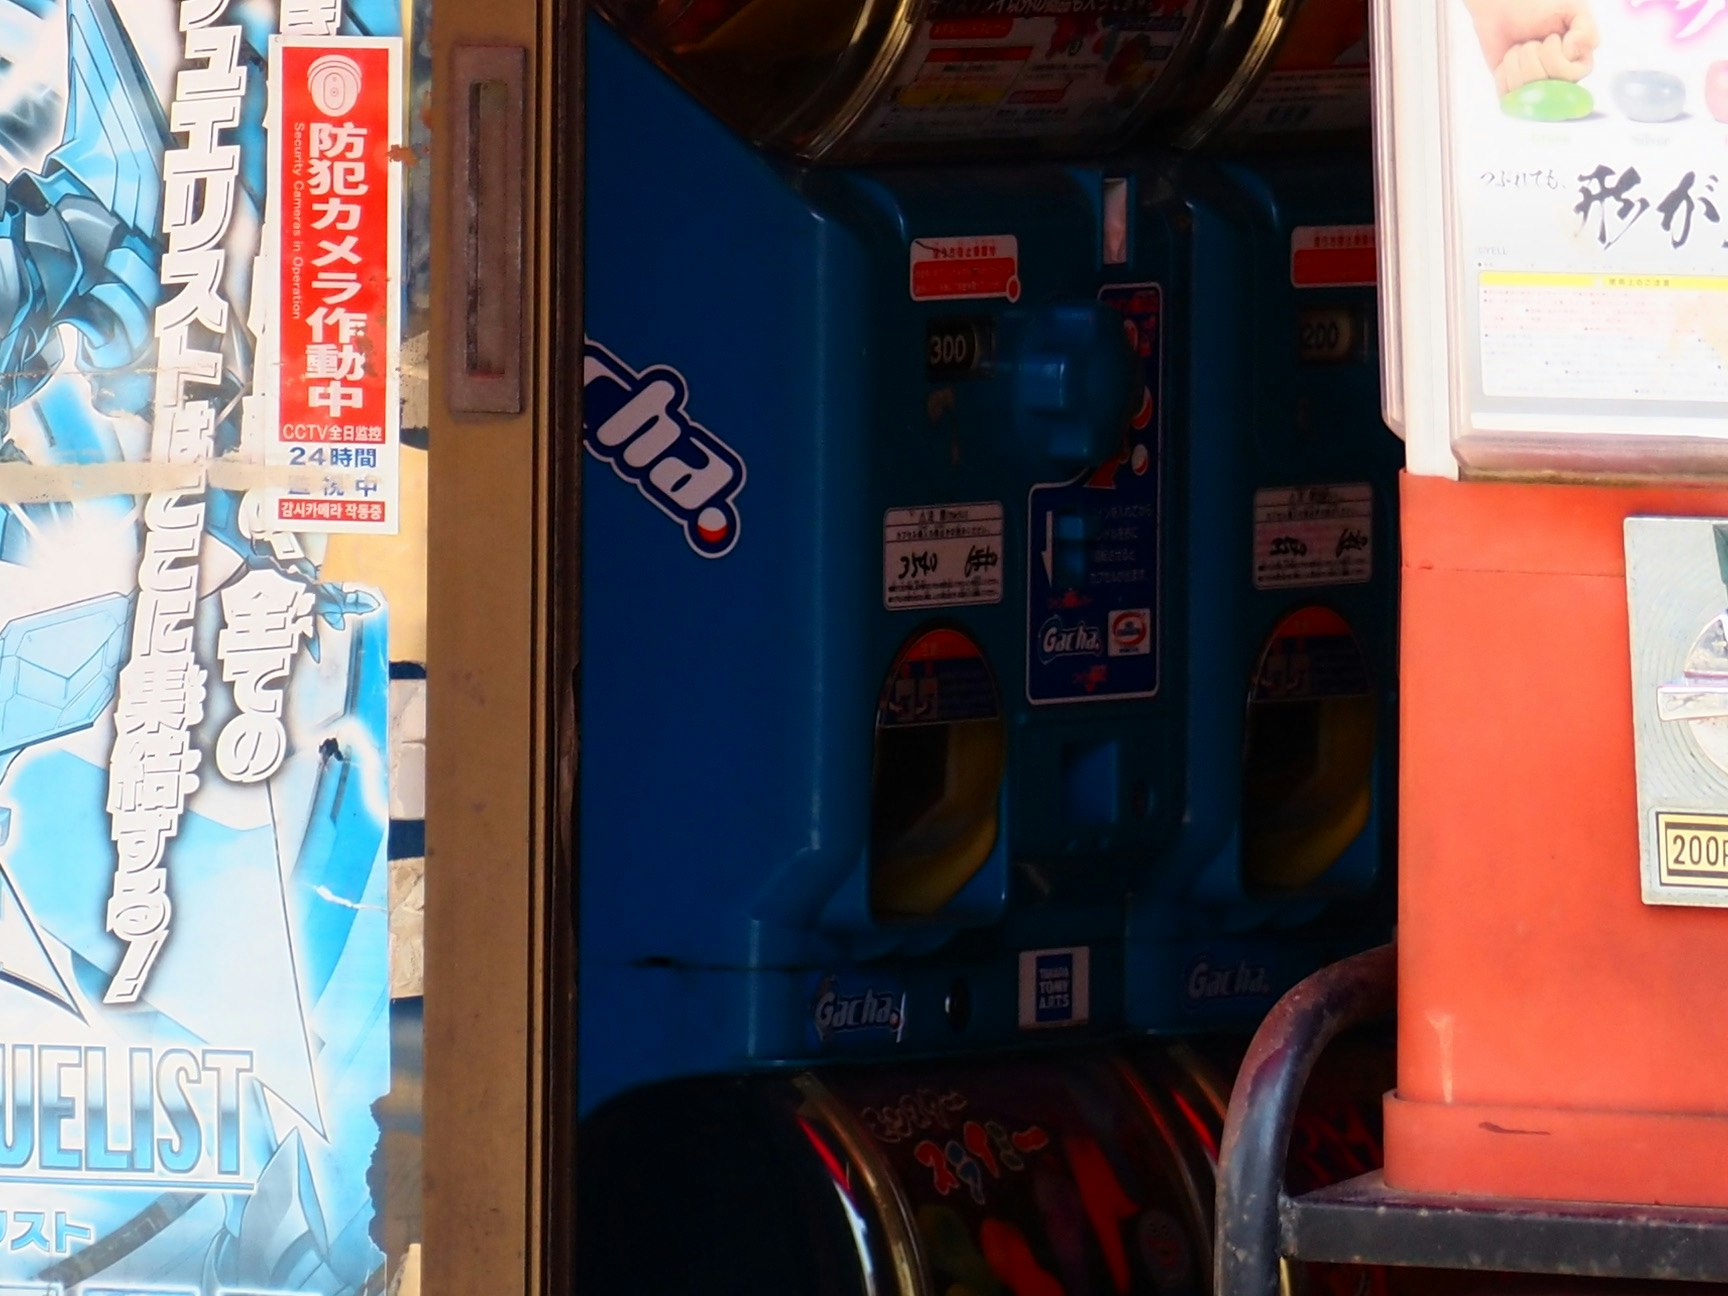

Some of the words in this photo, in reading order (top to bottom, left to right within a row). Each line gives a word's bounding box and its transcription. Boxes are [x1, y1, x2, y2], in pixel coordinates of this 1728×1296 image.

[292, 121, 305, 177] Security
[292, 181, 305, 237] Cameras
[292, 240, 304, 254] in
[292, 256, 305, 320] Operation
[304, 120, 369, 418] 防犯カメラ作動中
[930, 335, 967, 366] 300
[288, 446, 377, 468] 24時間
[281, 501, 342, 519] 감시카메라
